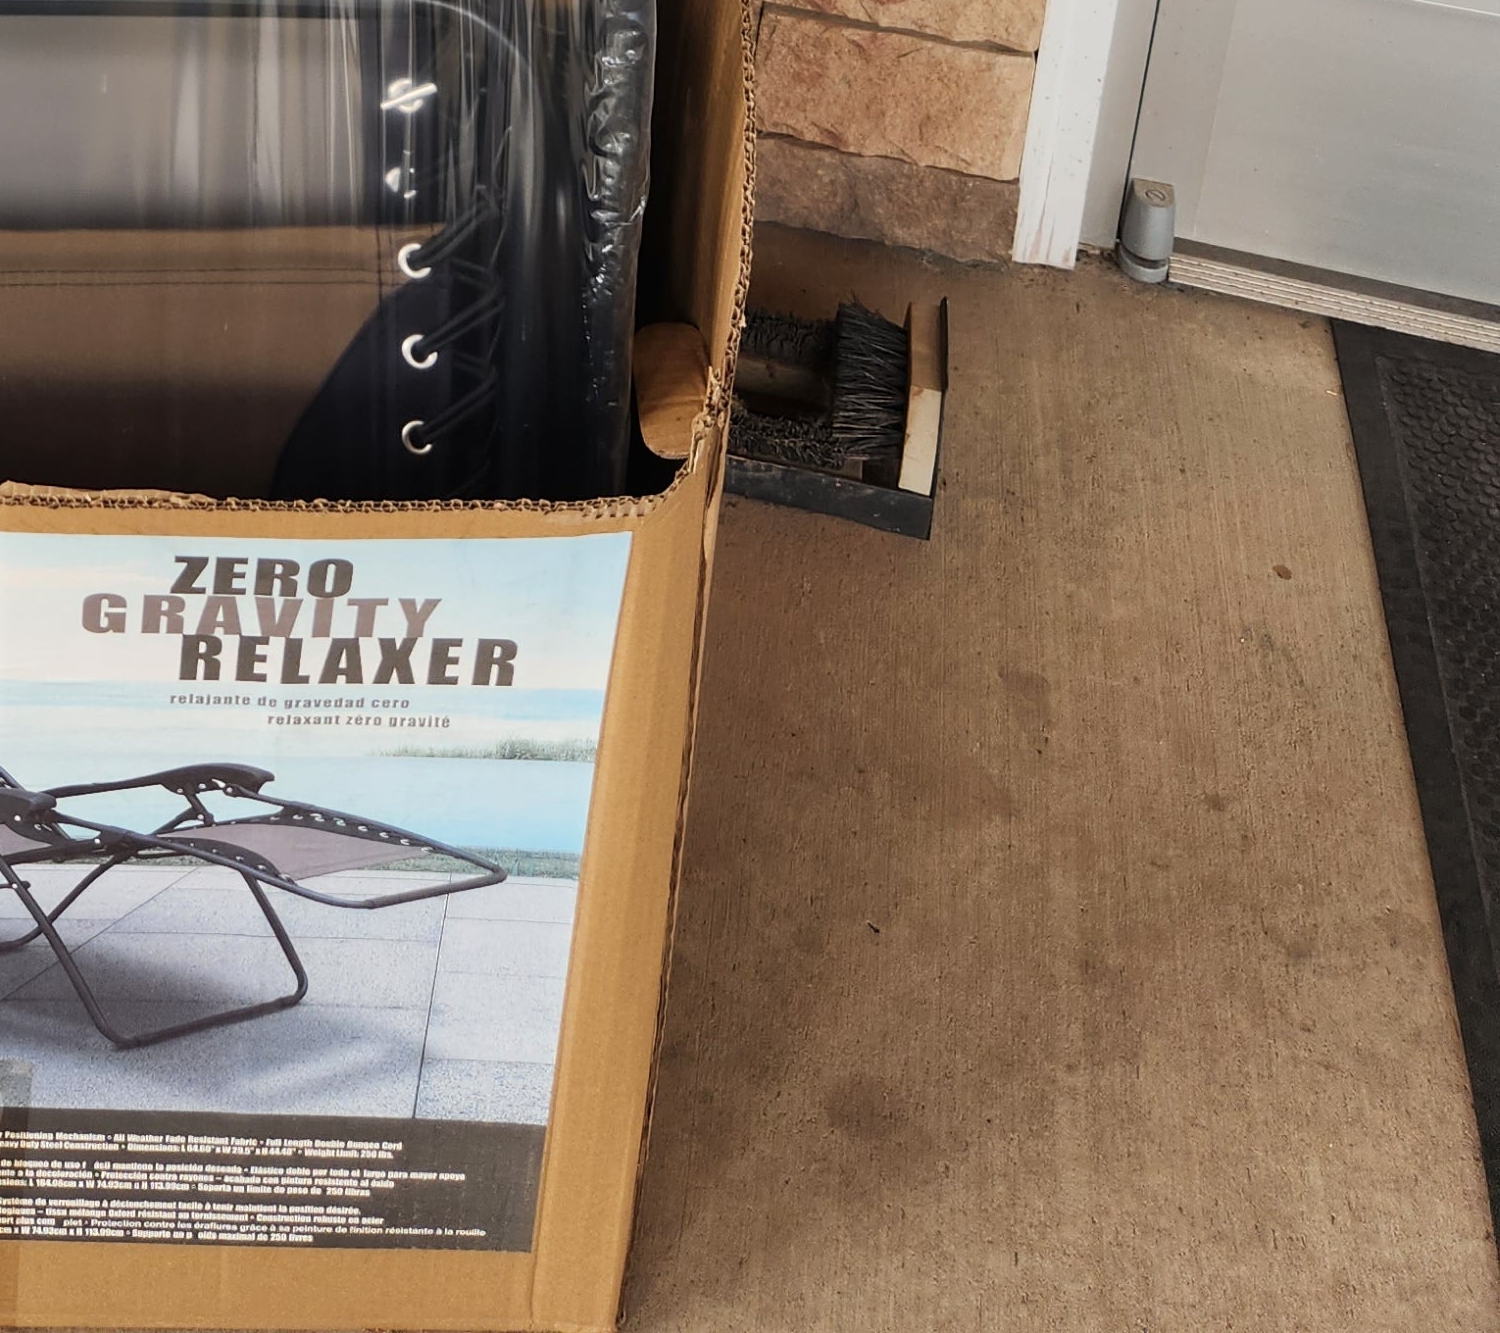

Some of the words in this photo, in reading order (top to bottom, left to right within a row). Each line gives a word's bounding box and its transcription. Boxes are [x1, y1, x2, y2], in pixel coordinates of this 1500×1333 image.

[170, 555, 354, 599] ZERO
[81, 593, 443, 638] GRAVITY
[179, 634, 519, 686] RELAXER
[169, 693, 251, 707] relajante
[257, 695, 277, 708] de
[283, 696, 365, 710] gravedad
[371, 697, 409, 709] cero
[267, 713, 340, 726] relaxant
[346, 714, 382, 726] zéro
[388, 715, 451, 729] gravité
